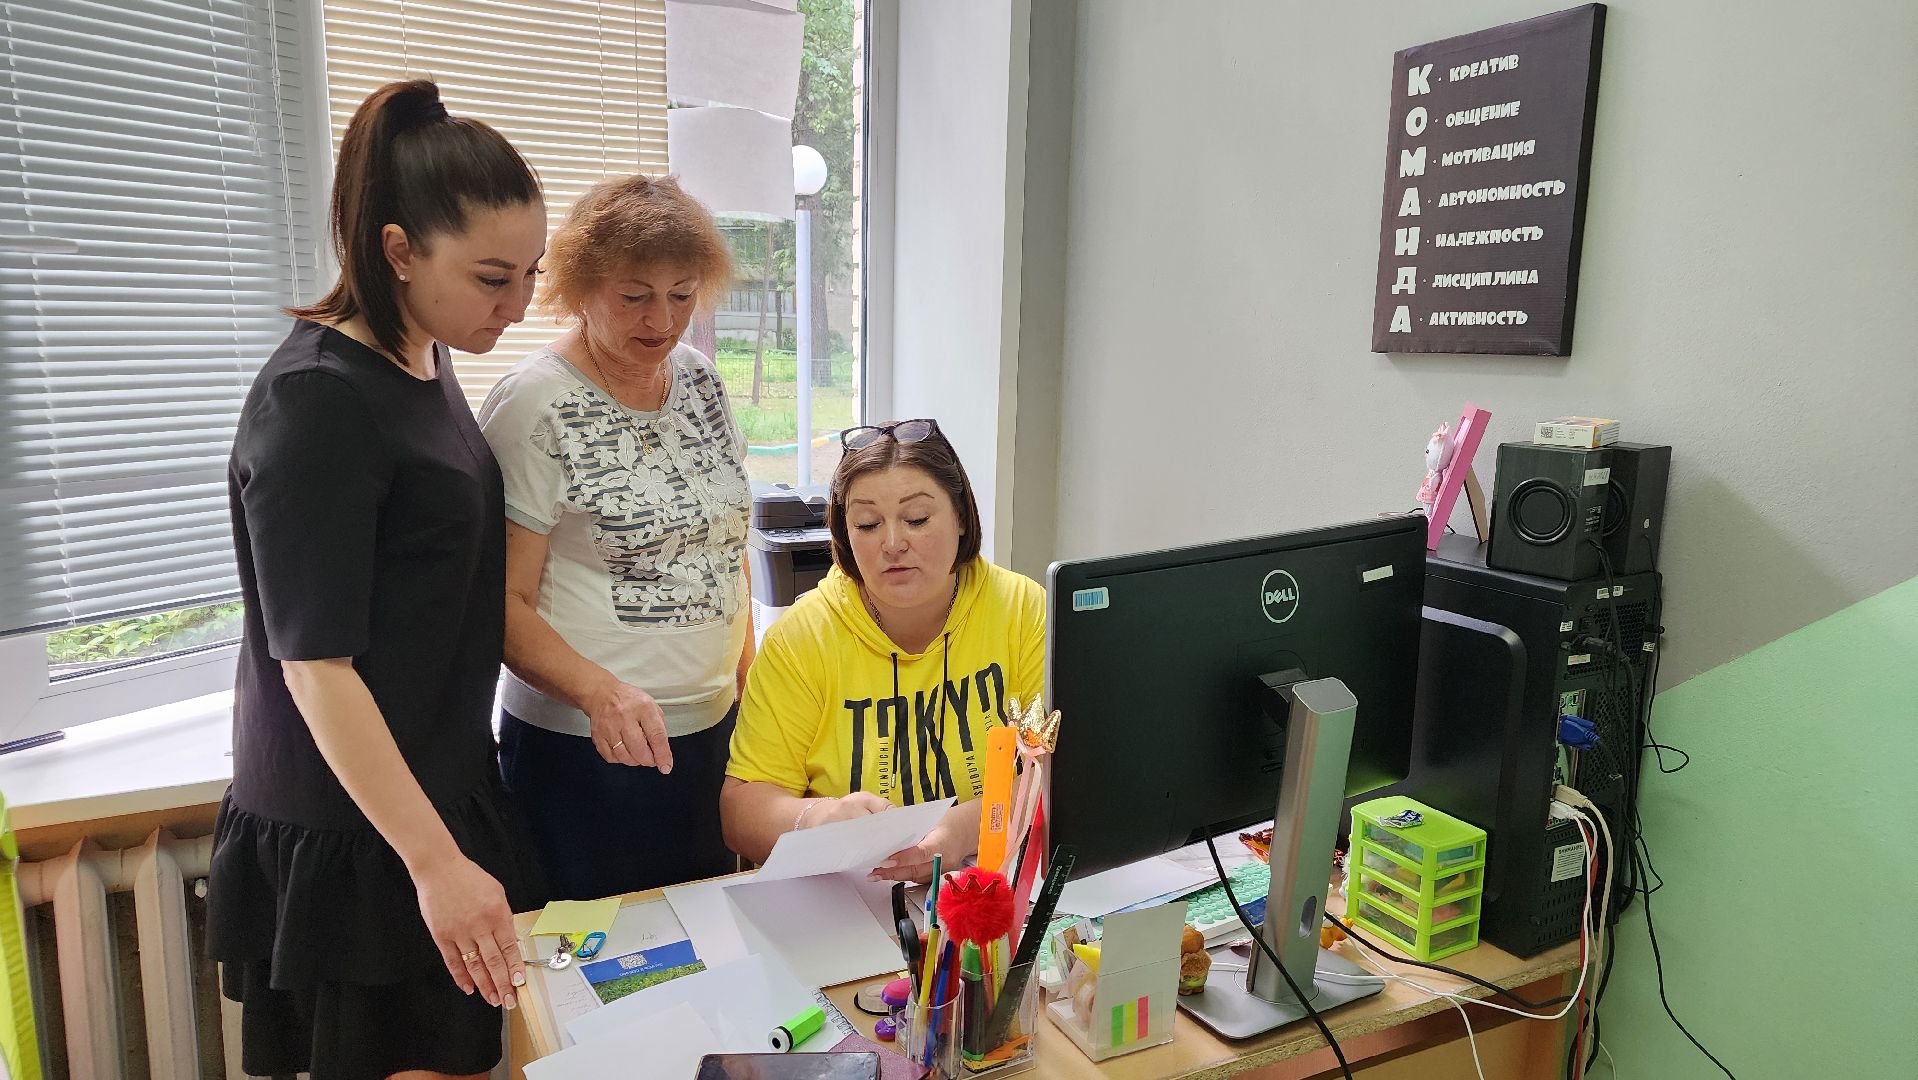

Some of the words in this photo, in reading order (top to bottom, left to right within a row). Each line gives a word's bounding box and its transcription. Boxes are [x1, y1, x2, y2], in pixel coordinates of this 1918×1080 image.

[1408, 64, 1433, 96] К
[1449, 54, 1520, 83] КРЕАТИВ
[1405, 106, 1428, 137] О
[1445, 100, 1521, 128] ОБЩЕНИЕ
[1399, 146, 1427, 178] М
[1441, 139, 1536, 168] МОТИВАЦИЯ
[1398, 187, 1421, 216] А
[1438, 179, 1566, 208] АВТОНОМНОСТЬ
[1395, 226, 1420, 256] Н
[1435, 225, 1544, 248] НАДЕЖНОСТЬ
[1391, 266, 1417, 295] Д
[1432, 269, 1539, 290] ДИСЦИПЛИНА
[1389, 305, 1412, 333] А
[1428, 310, 1529, 326] АКТИВНОСТЬ
[1265, 587, 1296, 605] DELL
